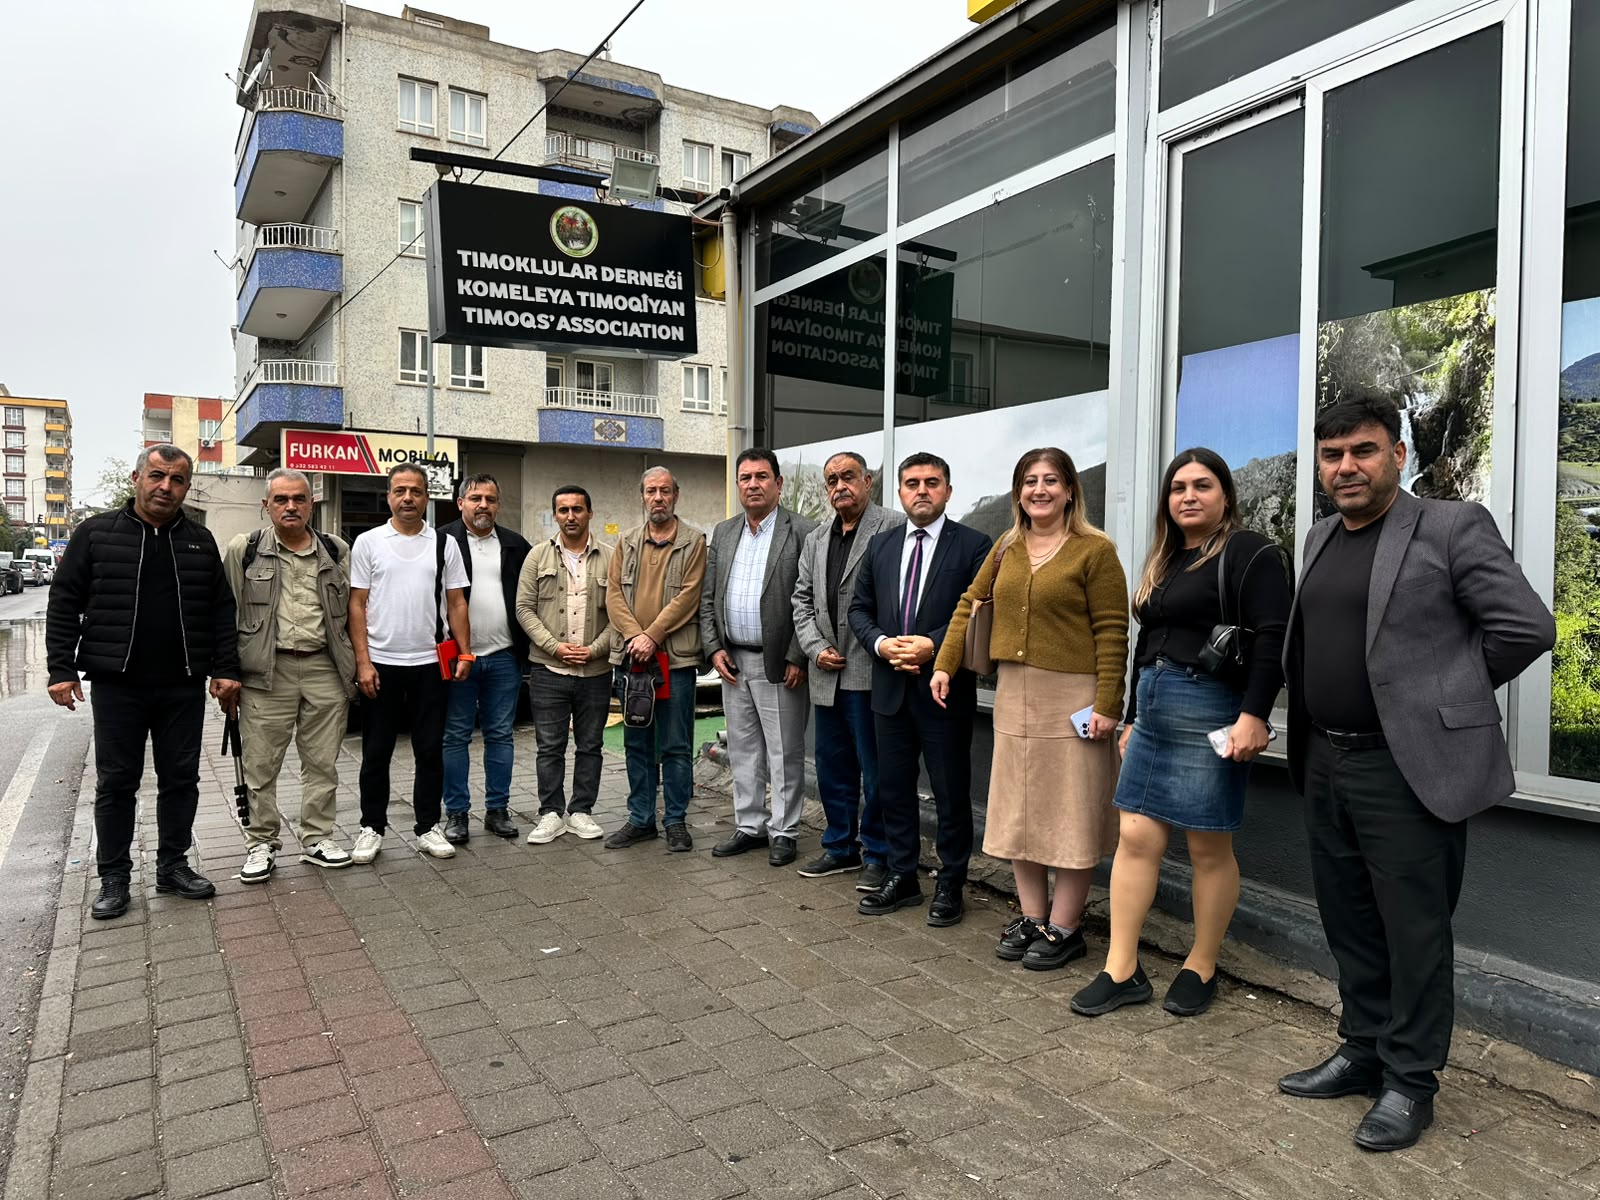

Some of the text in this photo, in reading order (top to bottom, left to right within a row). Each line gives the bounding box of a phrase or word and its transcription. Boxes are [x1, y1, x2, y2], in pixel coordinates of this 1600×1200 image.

[457, 249, 683, 290] TIMOKLULAR DERNEĞİ
[457, 278, 685, 317] KOMELEYA TIMOQÎYAN
[556, 315, 685, 341] ASSOCIATION
[289, 442, 359, 461] FURKAN
